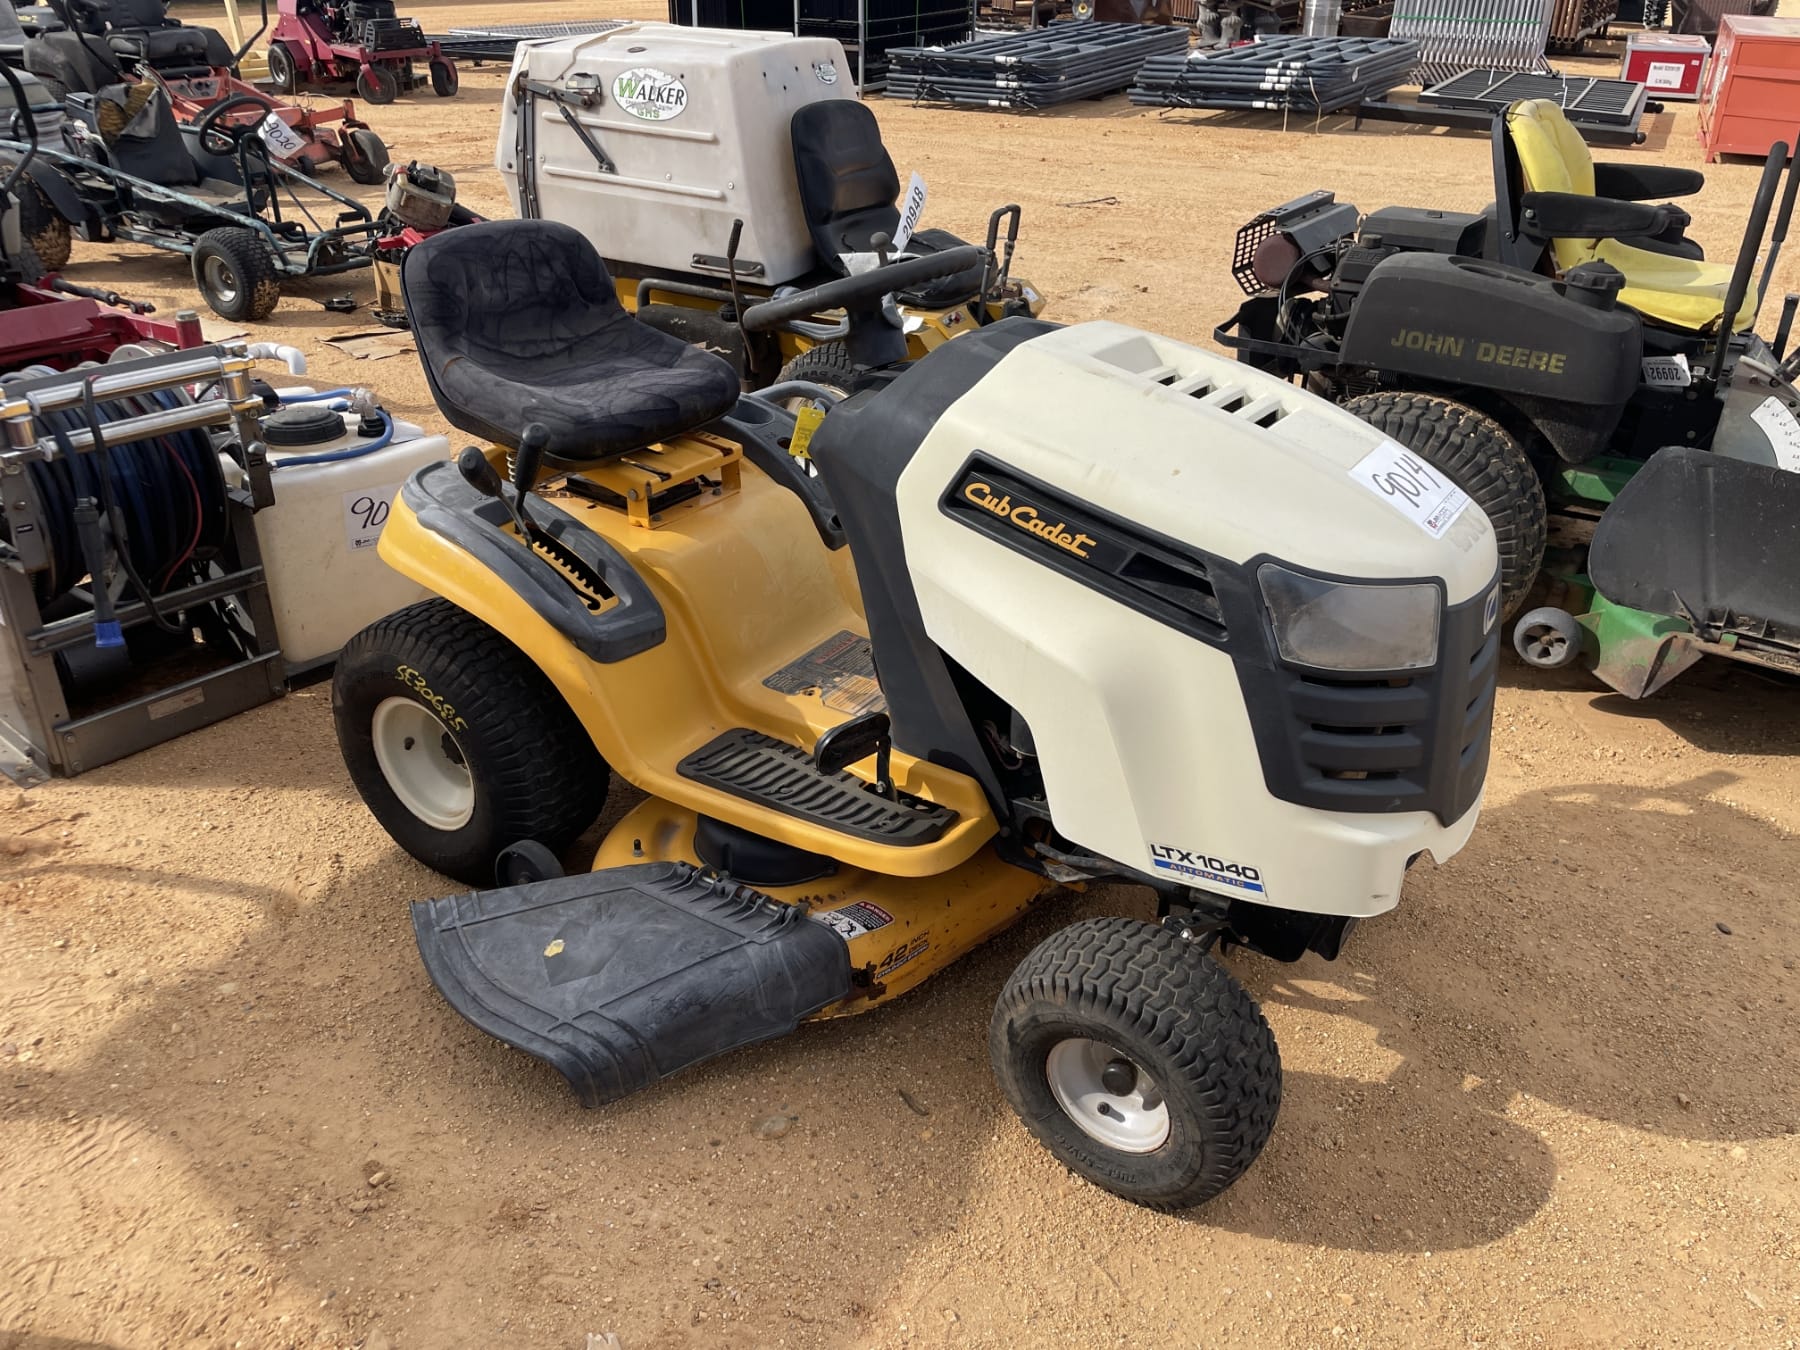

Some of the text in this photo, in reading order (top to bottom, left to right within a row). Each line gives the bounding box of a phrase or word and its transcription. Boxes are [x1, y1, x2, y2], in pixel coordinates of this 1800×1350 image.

[618, 77, 685, 106] WALKER
[266, 122, 296, 150] 9020
[903, 186, 924, 239] 20948
[1391, 328, 1567, 374] JOHN DEERE
[1649, 367, 1681, 381] 20992
[1372, 453, 1441, 508] 9014
[964, 482, 1097, 558] Cub Cadet
[1169, 863, 1245, 888] AUTOMATIC
[880, 944, 908, 968] 42
